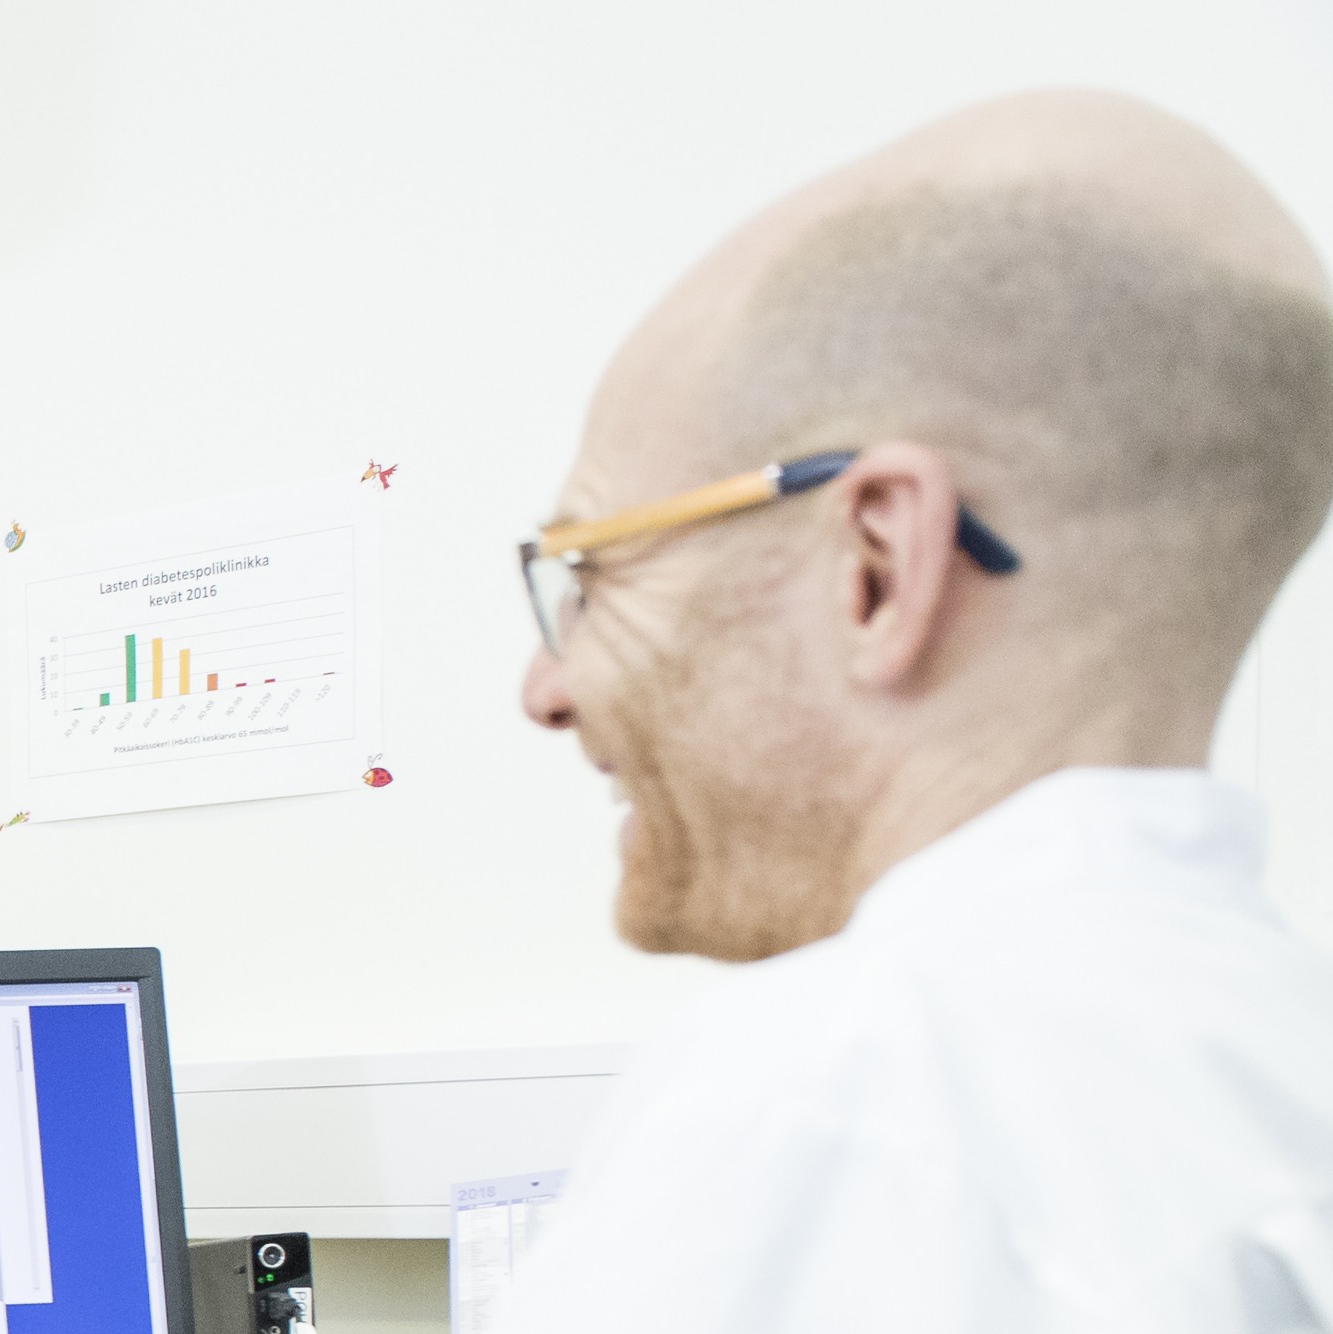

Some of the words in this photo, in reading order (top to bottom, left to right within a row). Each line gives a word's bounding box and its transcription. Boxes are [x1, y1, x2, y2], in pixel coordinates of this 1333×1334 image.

[99, 578, 138, 595] Lasten
[141, 554, 270, 587] diabetespoliklinikka
[149, 591, 183, 607] kevät
[186, 584, 218, 602] 2016
[238, 729, 248, 739] 65
[458, 1185, 496, 1201] 2018
